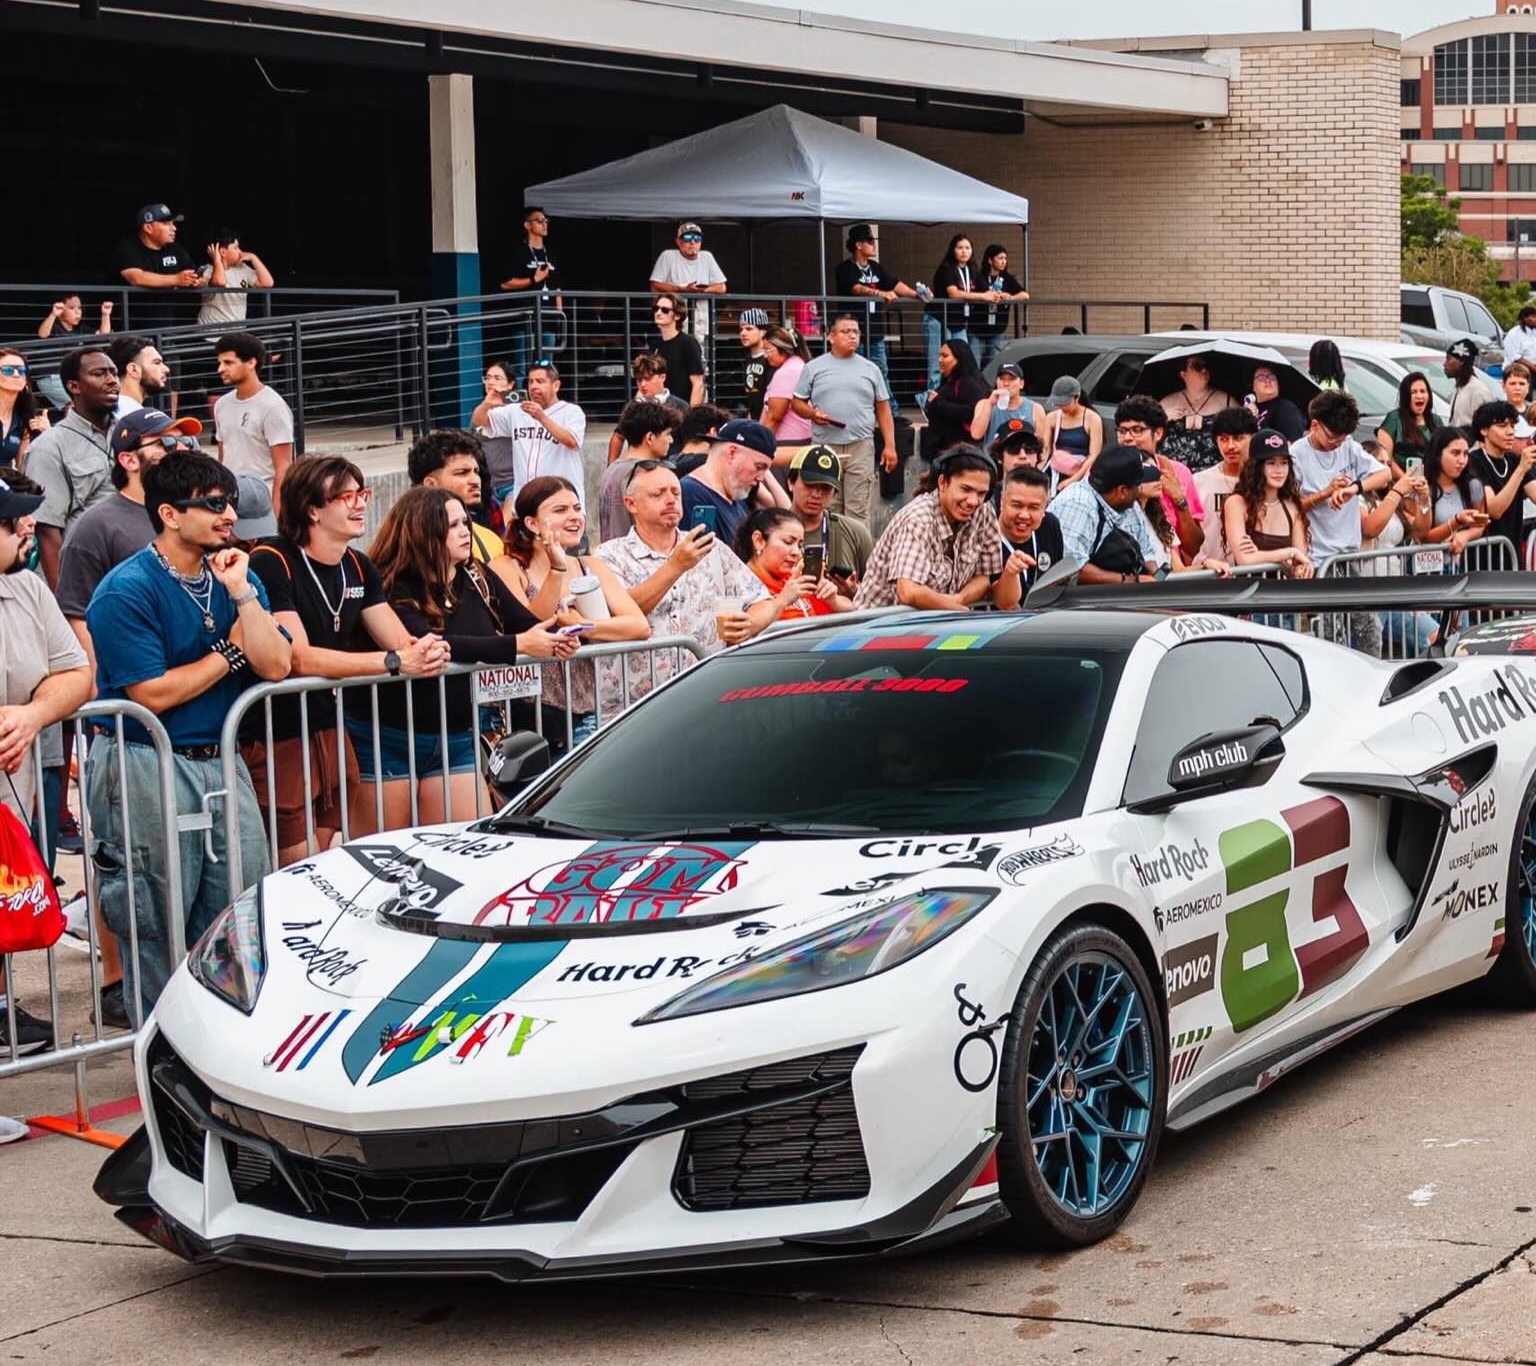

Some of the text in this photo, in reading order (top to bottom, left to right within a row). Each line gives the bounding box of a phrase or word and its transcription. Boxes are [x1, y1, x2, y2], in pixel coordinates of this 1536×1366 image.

[513, 426, 560, 445] STRO
[479, 665, 539, 688] NATIONAL
[718, 678, 969, 704] GUMBALL 3000
[1438, 669, 1526, 744] Hard
[1179, 741, 1248, 777] mph club
[1129, 837, 1209, 887] Hard Rock
[1448, 842, 1498, 871] ULYSSE NARDIN
[1165, 892, 1223, 926] AEROMEXICO
[1441, 881, 1499, 922] MONEX
[557, 957, 666, 982] Hard
[1166, 954, 1212, 999] enovo
